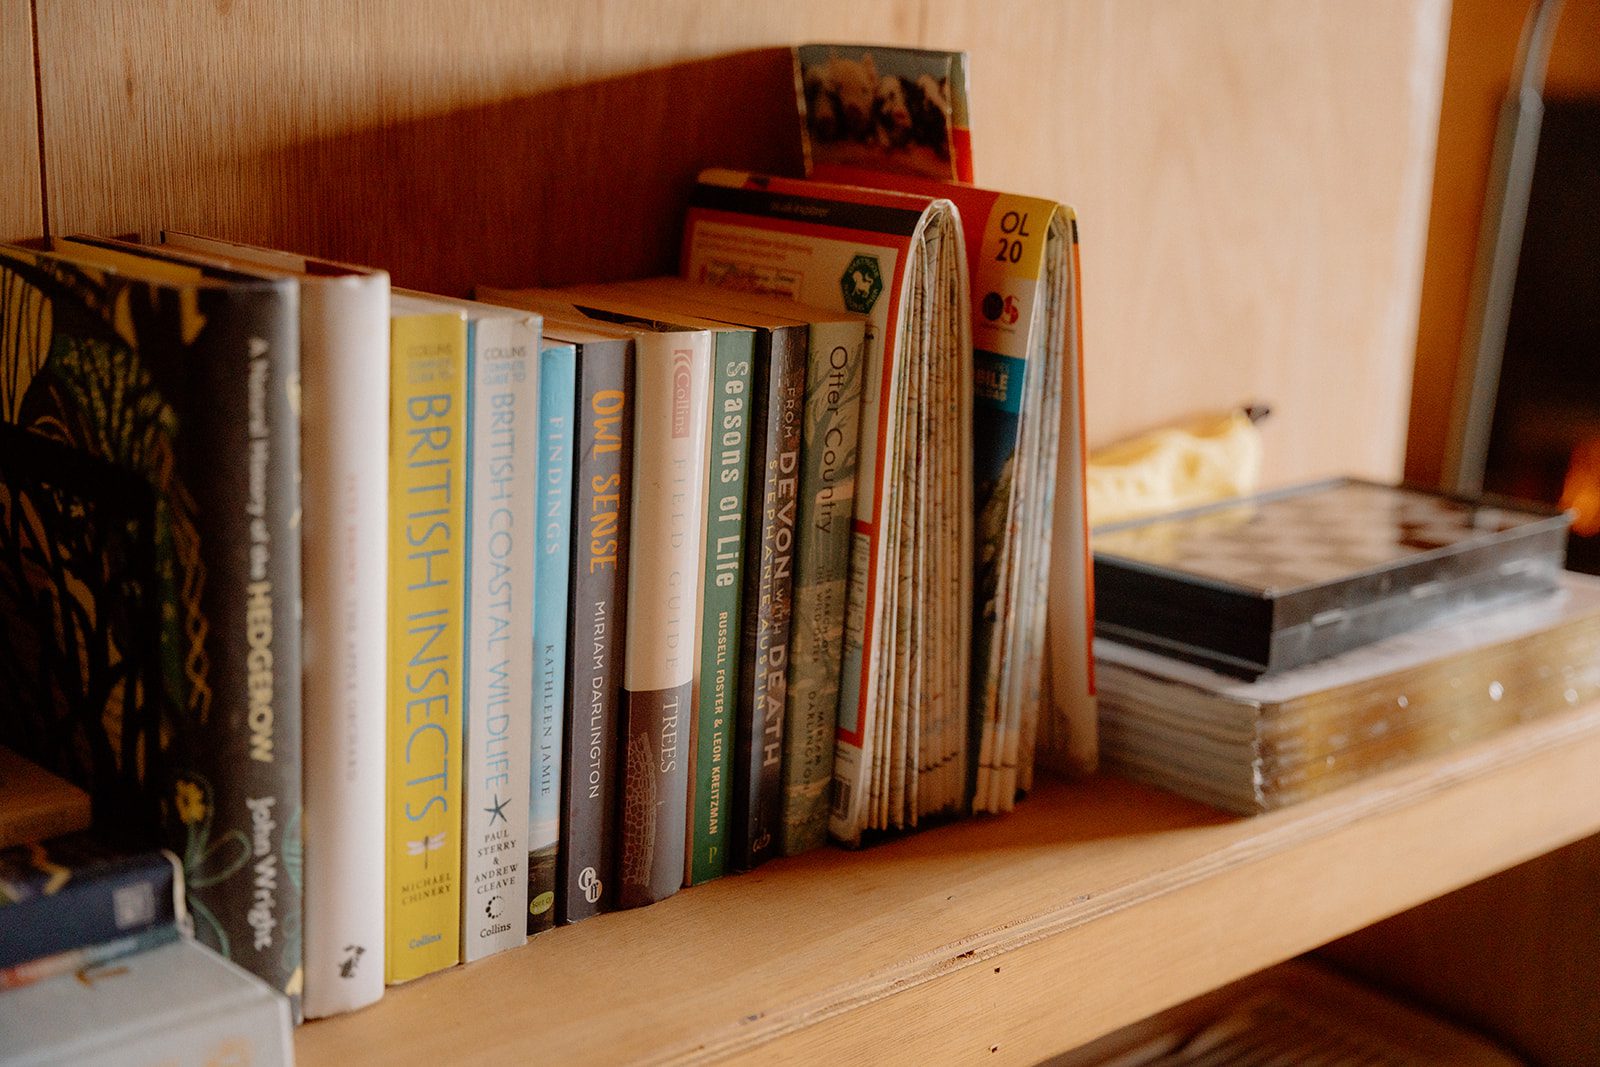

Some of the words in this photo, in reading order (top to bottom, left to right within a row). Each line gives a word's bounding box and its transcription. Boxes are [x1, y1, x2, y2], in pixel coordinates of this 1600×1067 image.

[995, 238, 1023, 264] 20
[1000, 211, 1029, 238] OL
[673, 373, 690, 434] Collins
[783, 386, 796, 438] FROM
[827, 346, 849, 416] Otter
[489, 392, 516, 501] BRITISH
[592, 389, 625, 460] OWL
[720, 360, 749, 484] Seasons
[406, 393, 452, 591] BRITISH
[546, 415, 564, 555] FINDINGS
[718, 495, 742, 522] of
[773, 451, 797, 579] DEVON
[814, 428, 843, 535] Country
[590, 473, 621, 575] SENSE
[760, 459, 779, 608] STEPHANIE
[487, 508, 513, 655] COASTAL
[715, 533, 740, 588] Life
[592, 600, 606, 670] MIRIAM
[715, 611, 728, 666] RUSSELL
[773, 588, 785, 636] WITH
[543, 644, 555, 738] KATHLEEN
[714, 667, 725, 714] FOSTER
[757, 620, 770, 710] AUSTIN
[405, 609, 452, 822] INSECTS
[485, 660, 512, 790] WILDLIFE
[588, 676, 603, 799] DARLINGTON
[660, 695, 679, 774] TREES
[713, 718, 723, 728] &
[763, 644, 786, 768] DEATH
[541, 743, 552, 798] JAMIE
[711, 730, 722, 764] LEON
[708, 765, 721, 836] KREITZMAN
[477, 840, 516, 858] STERRY
[484, 829, 510, 844] PAUL
[493, 857, 499, 865] &
[474, 864, 518, 885] ANDREW
[476, 876, 516, 896] CLEAVE
[479, 922, 512, 940] Collins
